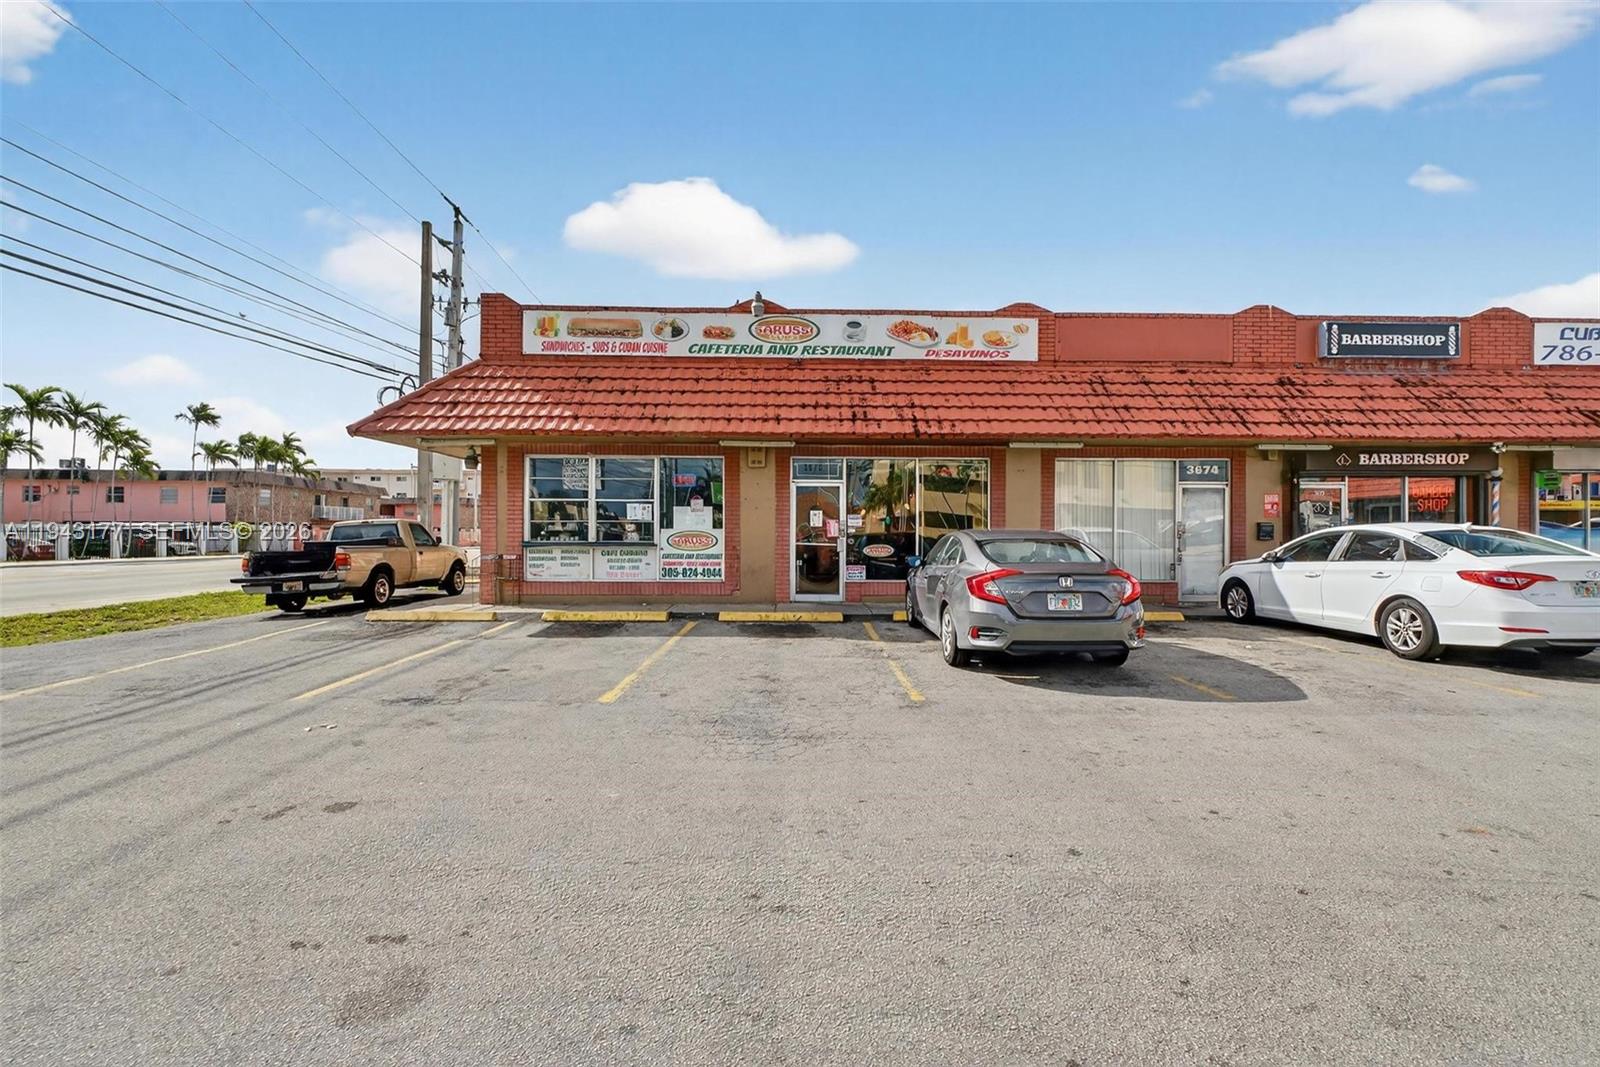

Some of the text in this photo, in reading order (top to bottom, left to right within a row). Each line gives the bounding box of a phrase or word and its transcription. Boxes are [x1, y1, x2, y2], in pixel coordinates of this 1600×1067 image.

[1341, 334, 1446, 346] BARBERSHOP
[541, 341, 585, 352] SANDWICHES
[592, 342, 610, 353] SUBS
[643, 343, 669, 353] CUISINE
[688, 343, 895, 357] CAFETERIA AND RESTAURANT
[1359, 453, 1469, 465] BARBERSHOP
[1186, 465, 1219, 475] 3674
[1412, 485, 1453, 498] BARBER
[1417, 498, 1449, 513] SHOP
